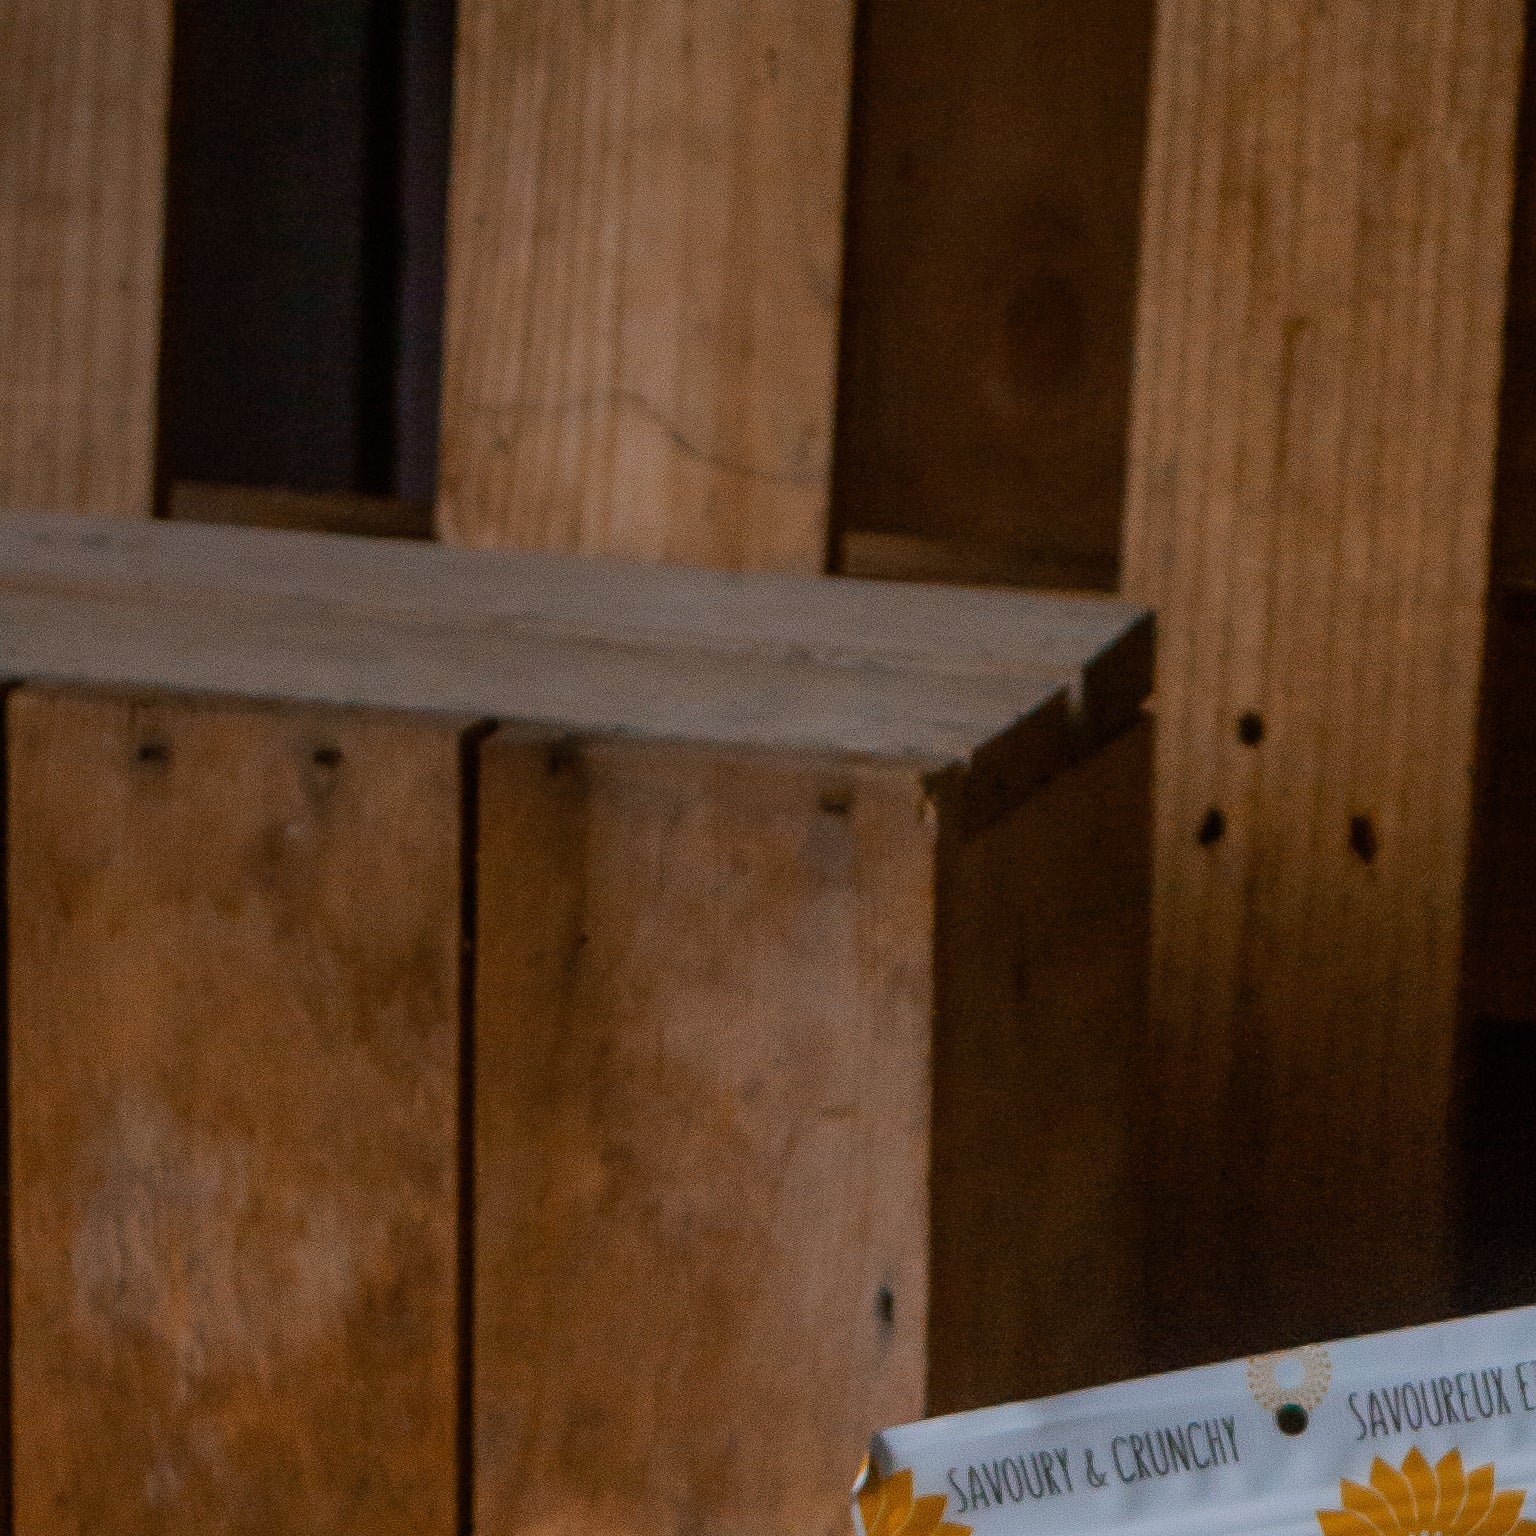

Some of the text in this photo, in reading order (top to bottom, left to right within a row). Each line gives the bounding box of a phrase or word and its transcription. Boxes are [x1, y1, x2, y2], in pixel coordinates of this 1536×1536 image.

[1348, 1366, 1512, 1441] SAVOUREUX
[947, 1415, 1241, 1514] SAVOURY & CRUNCHY
